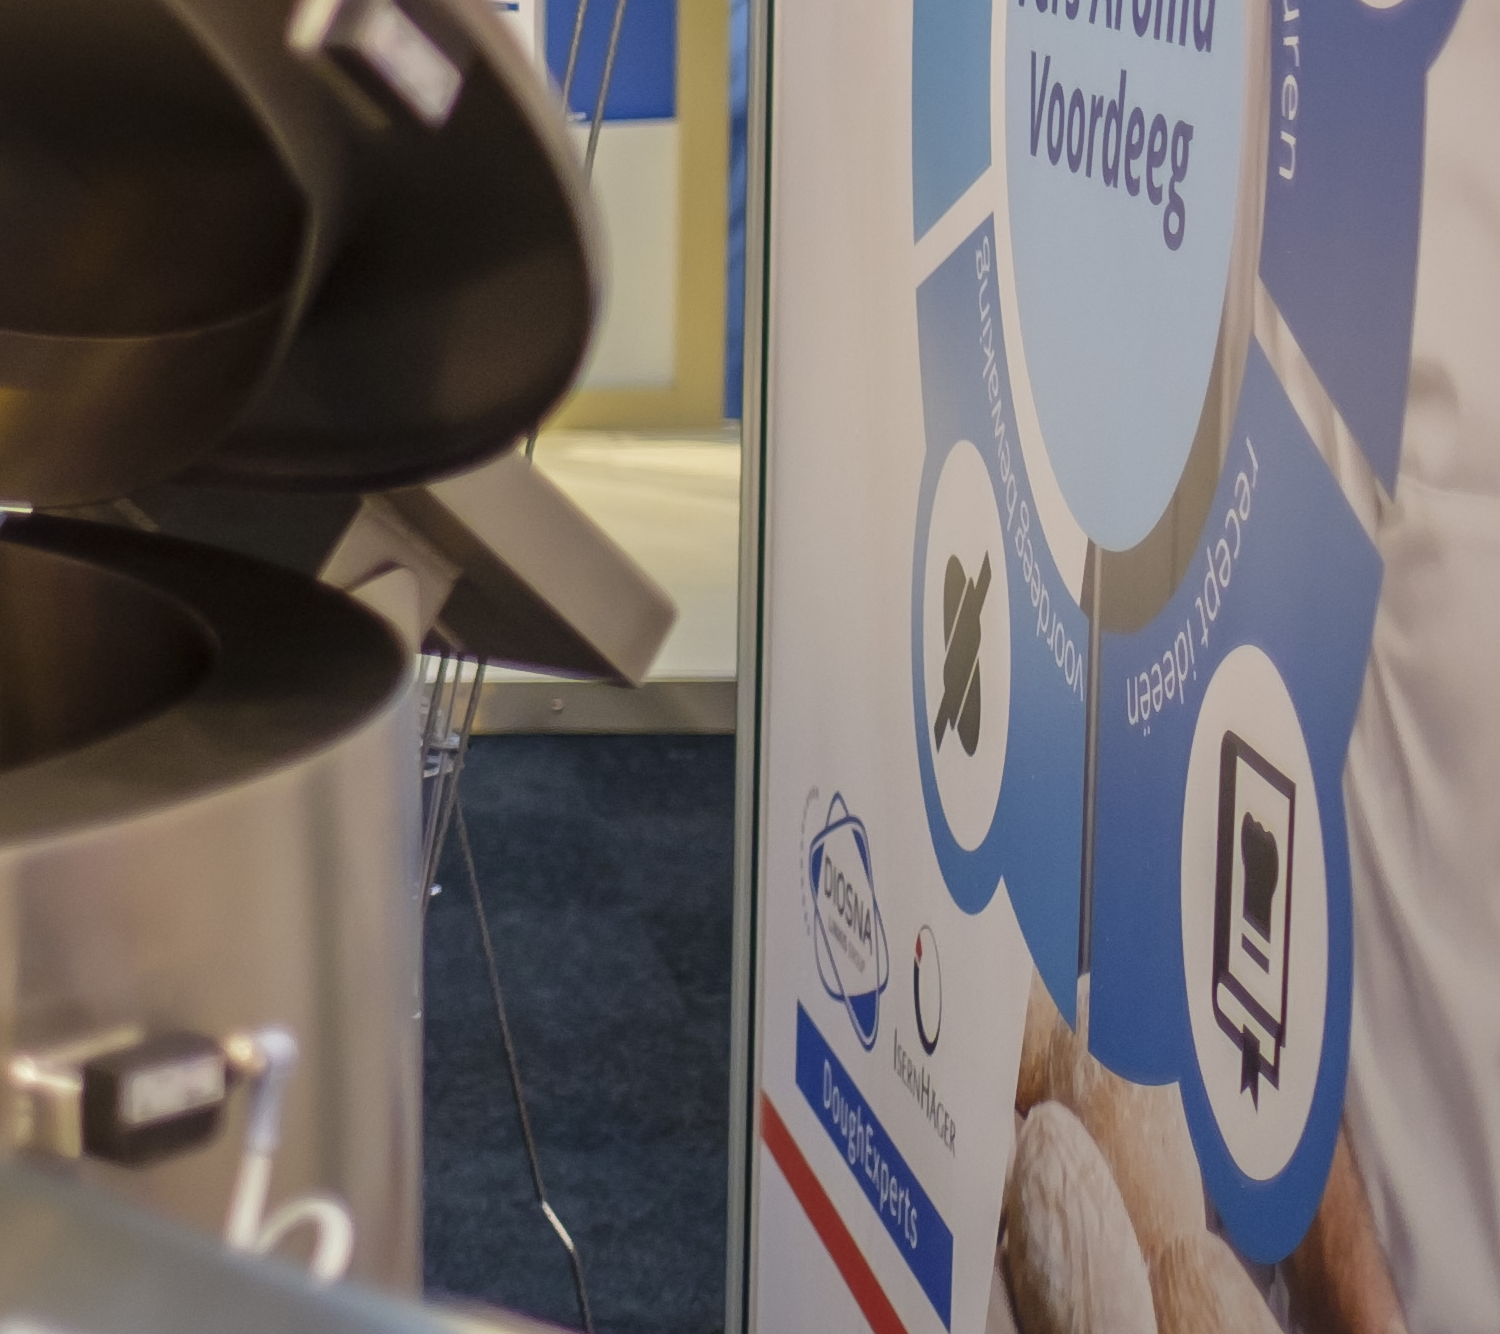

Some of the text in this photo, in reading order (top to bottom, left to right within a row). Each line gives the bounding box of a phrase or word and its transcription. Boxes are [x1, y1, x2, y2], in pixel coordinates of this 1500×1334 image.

[1028, 51, 1194, 251] Voordeeg
[975, 235, 1084, 702] voordeeg bewaking
[1126, 436, 1260, 737] recept ideeën
[824, 854, 873, 957] DIOSNA
[822, 1058, 919, 1251] DoughExperts
